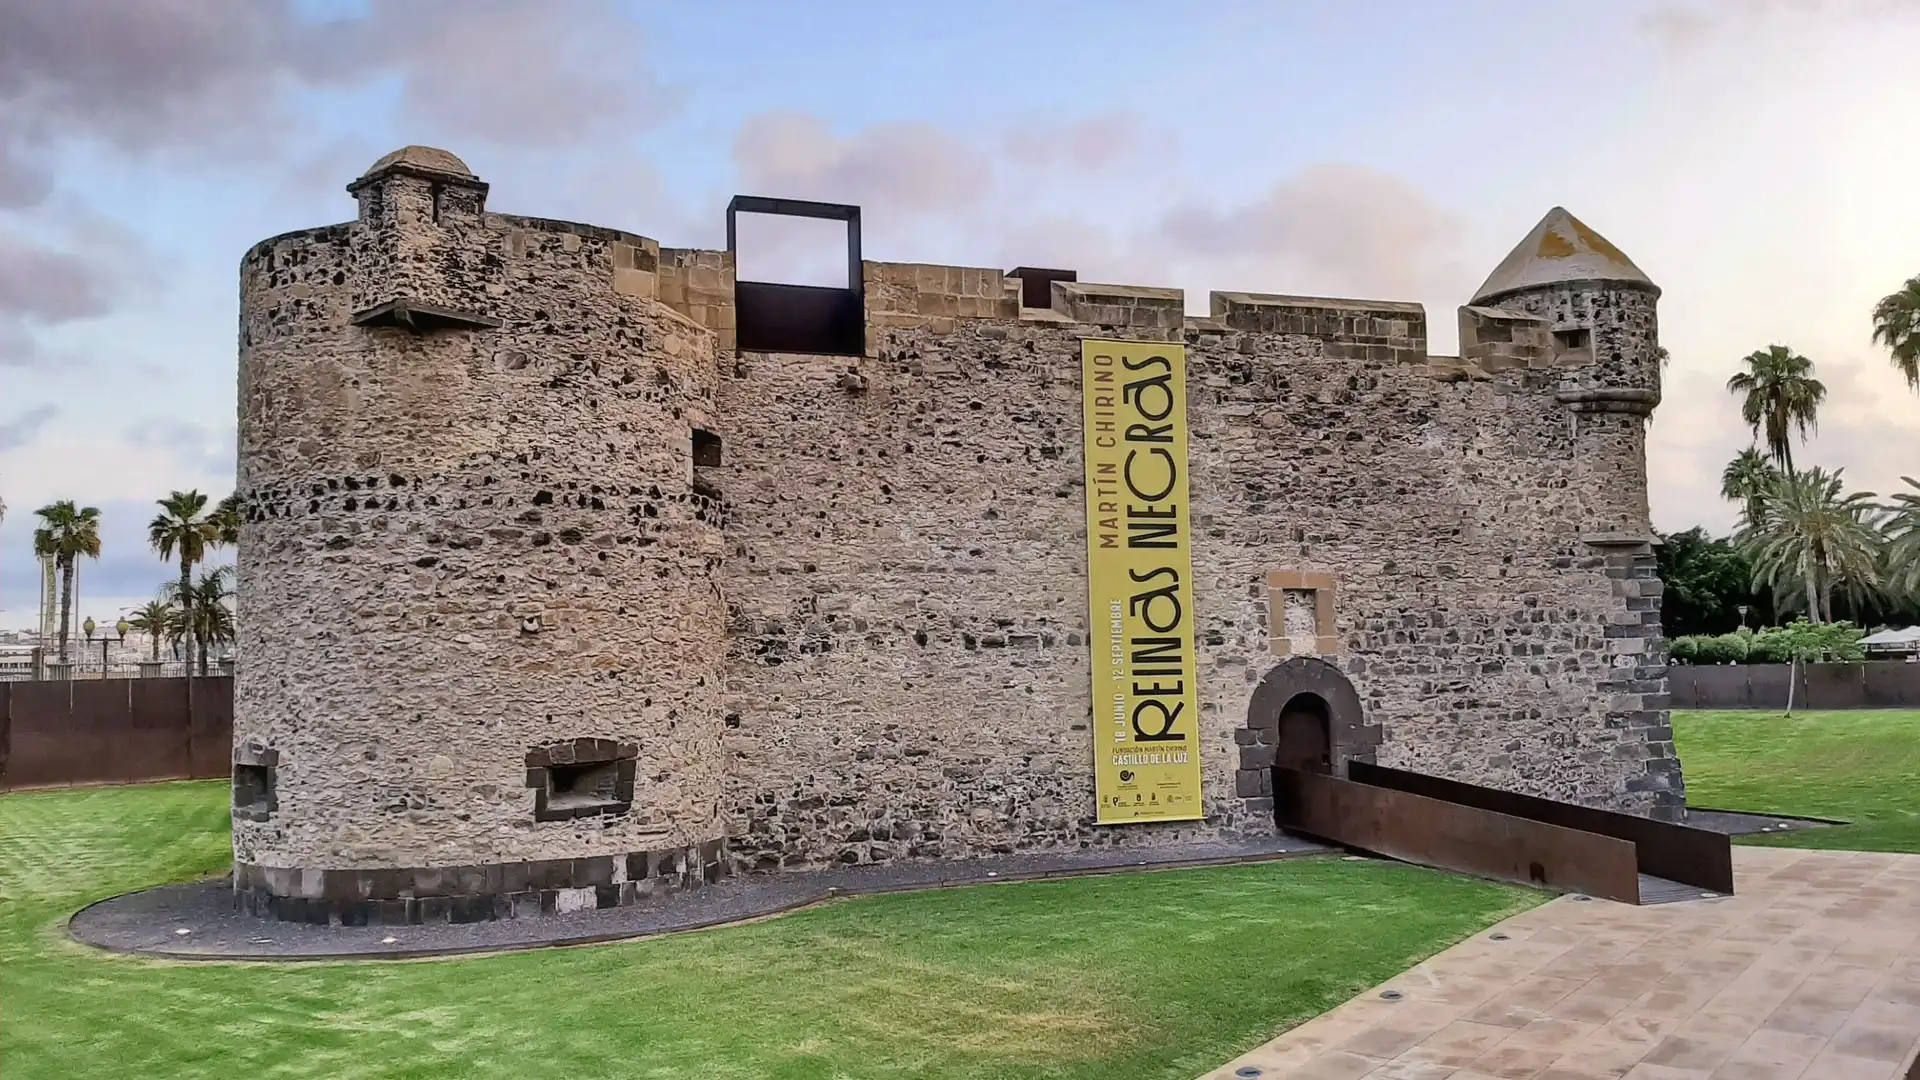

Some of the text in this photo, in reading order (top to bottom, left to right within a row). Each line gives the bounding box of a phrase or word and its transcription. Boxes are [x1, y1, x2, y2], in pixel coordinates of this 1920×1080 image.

[1093, 355, 1119, 549] MARTÍN CHIRINO
[1110, 598, 1124, 665] SEPTIEMBRE
[1112, 668, 1125, 681] 12
[1113, 693, 1126, 727] JUNIO
[1114, 731, 1126, 743] 18
[1112, 752, 1188, 766] CASTILLO DE LA LUZ
